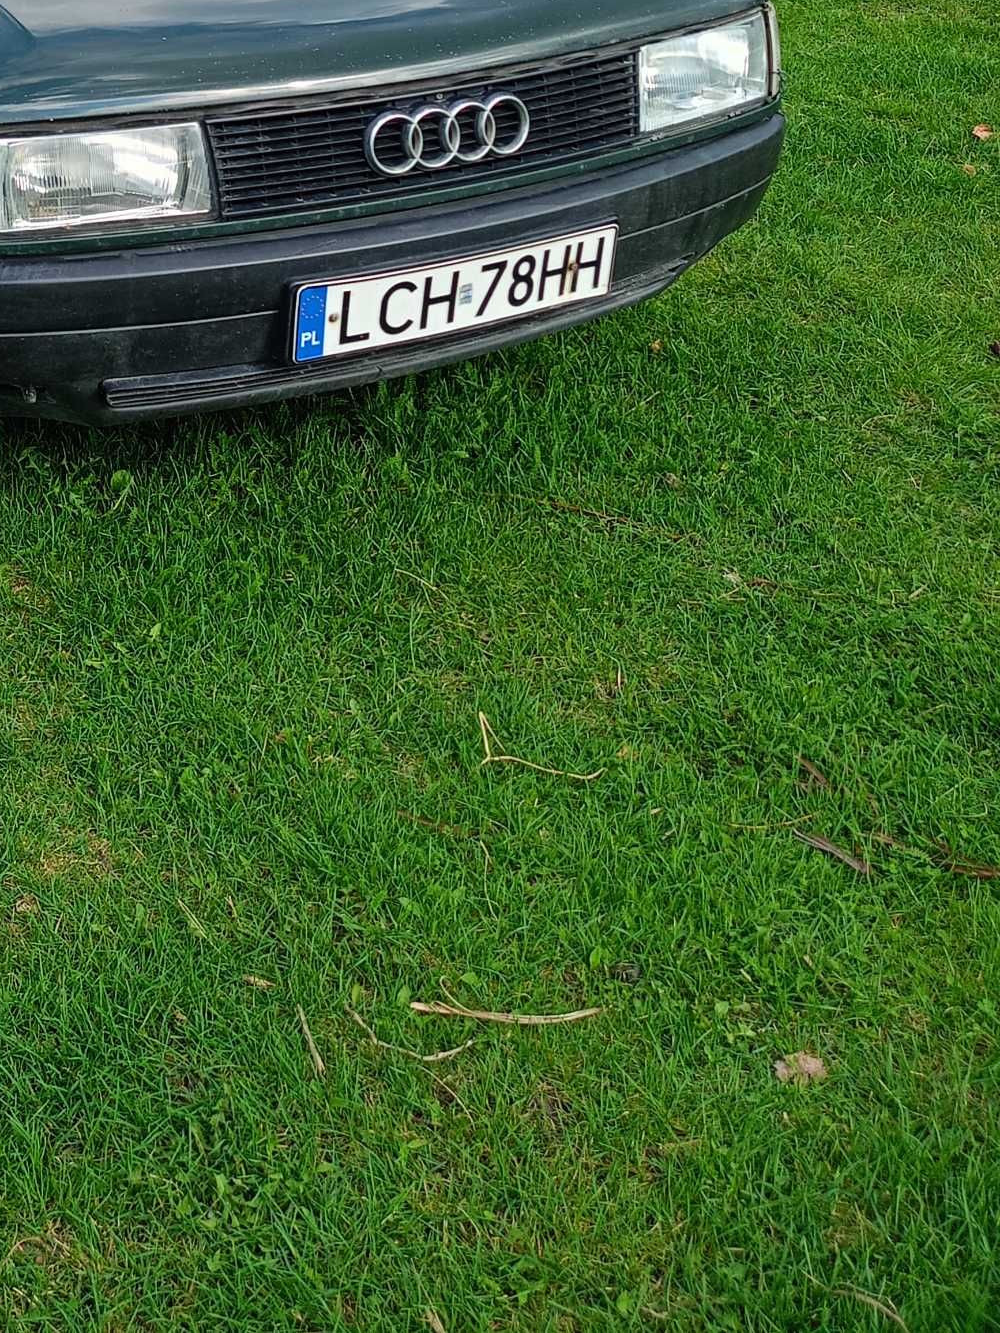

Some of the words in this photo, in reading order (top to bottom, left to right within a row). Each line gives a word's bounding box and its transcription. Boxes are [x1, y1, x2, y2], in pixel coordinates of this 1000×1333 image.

[338, 270, 460, 346] LCH
[474, 237, 606, 317] 78HH
[301, 331, 320, 348] PL
